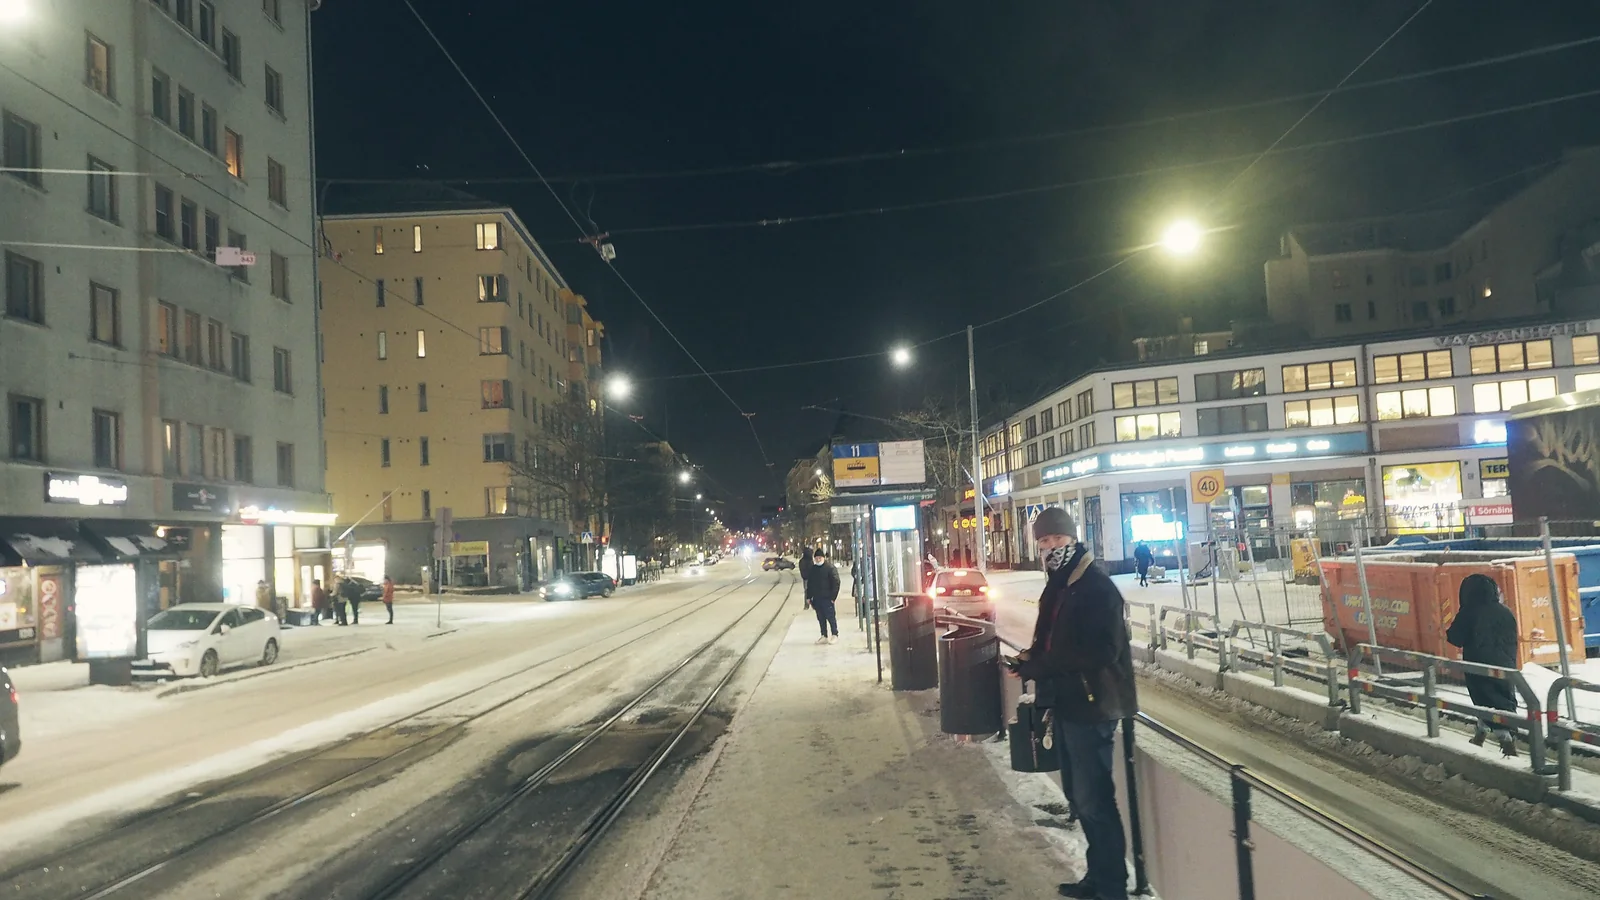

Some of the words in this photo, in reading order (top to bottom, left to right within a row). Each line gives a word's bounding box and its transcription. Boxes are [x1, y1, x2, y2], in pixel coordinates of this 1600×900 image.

[850, 445, 860, 457] 11
[1486, 464, 1508, 474] TER
[1201, 480, 1216, 492] 40
